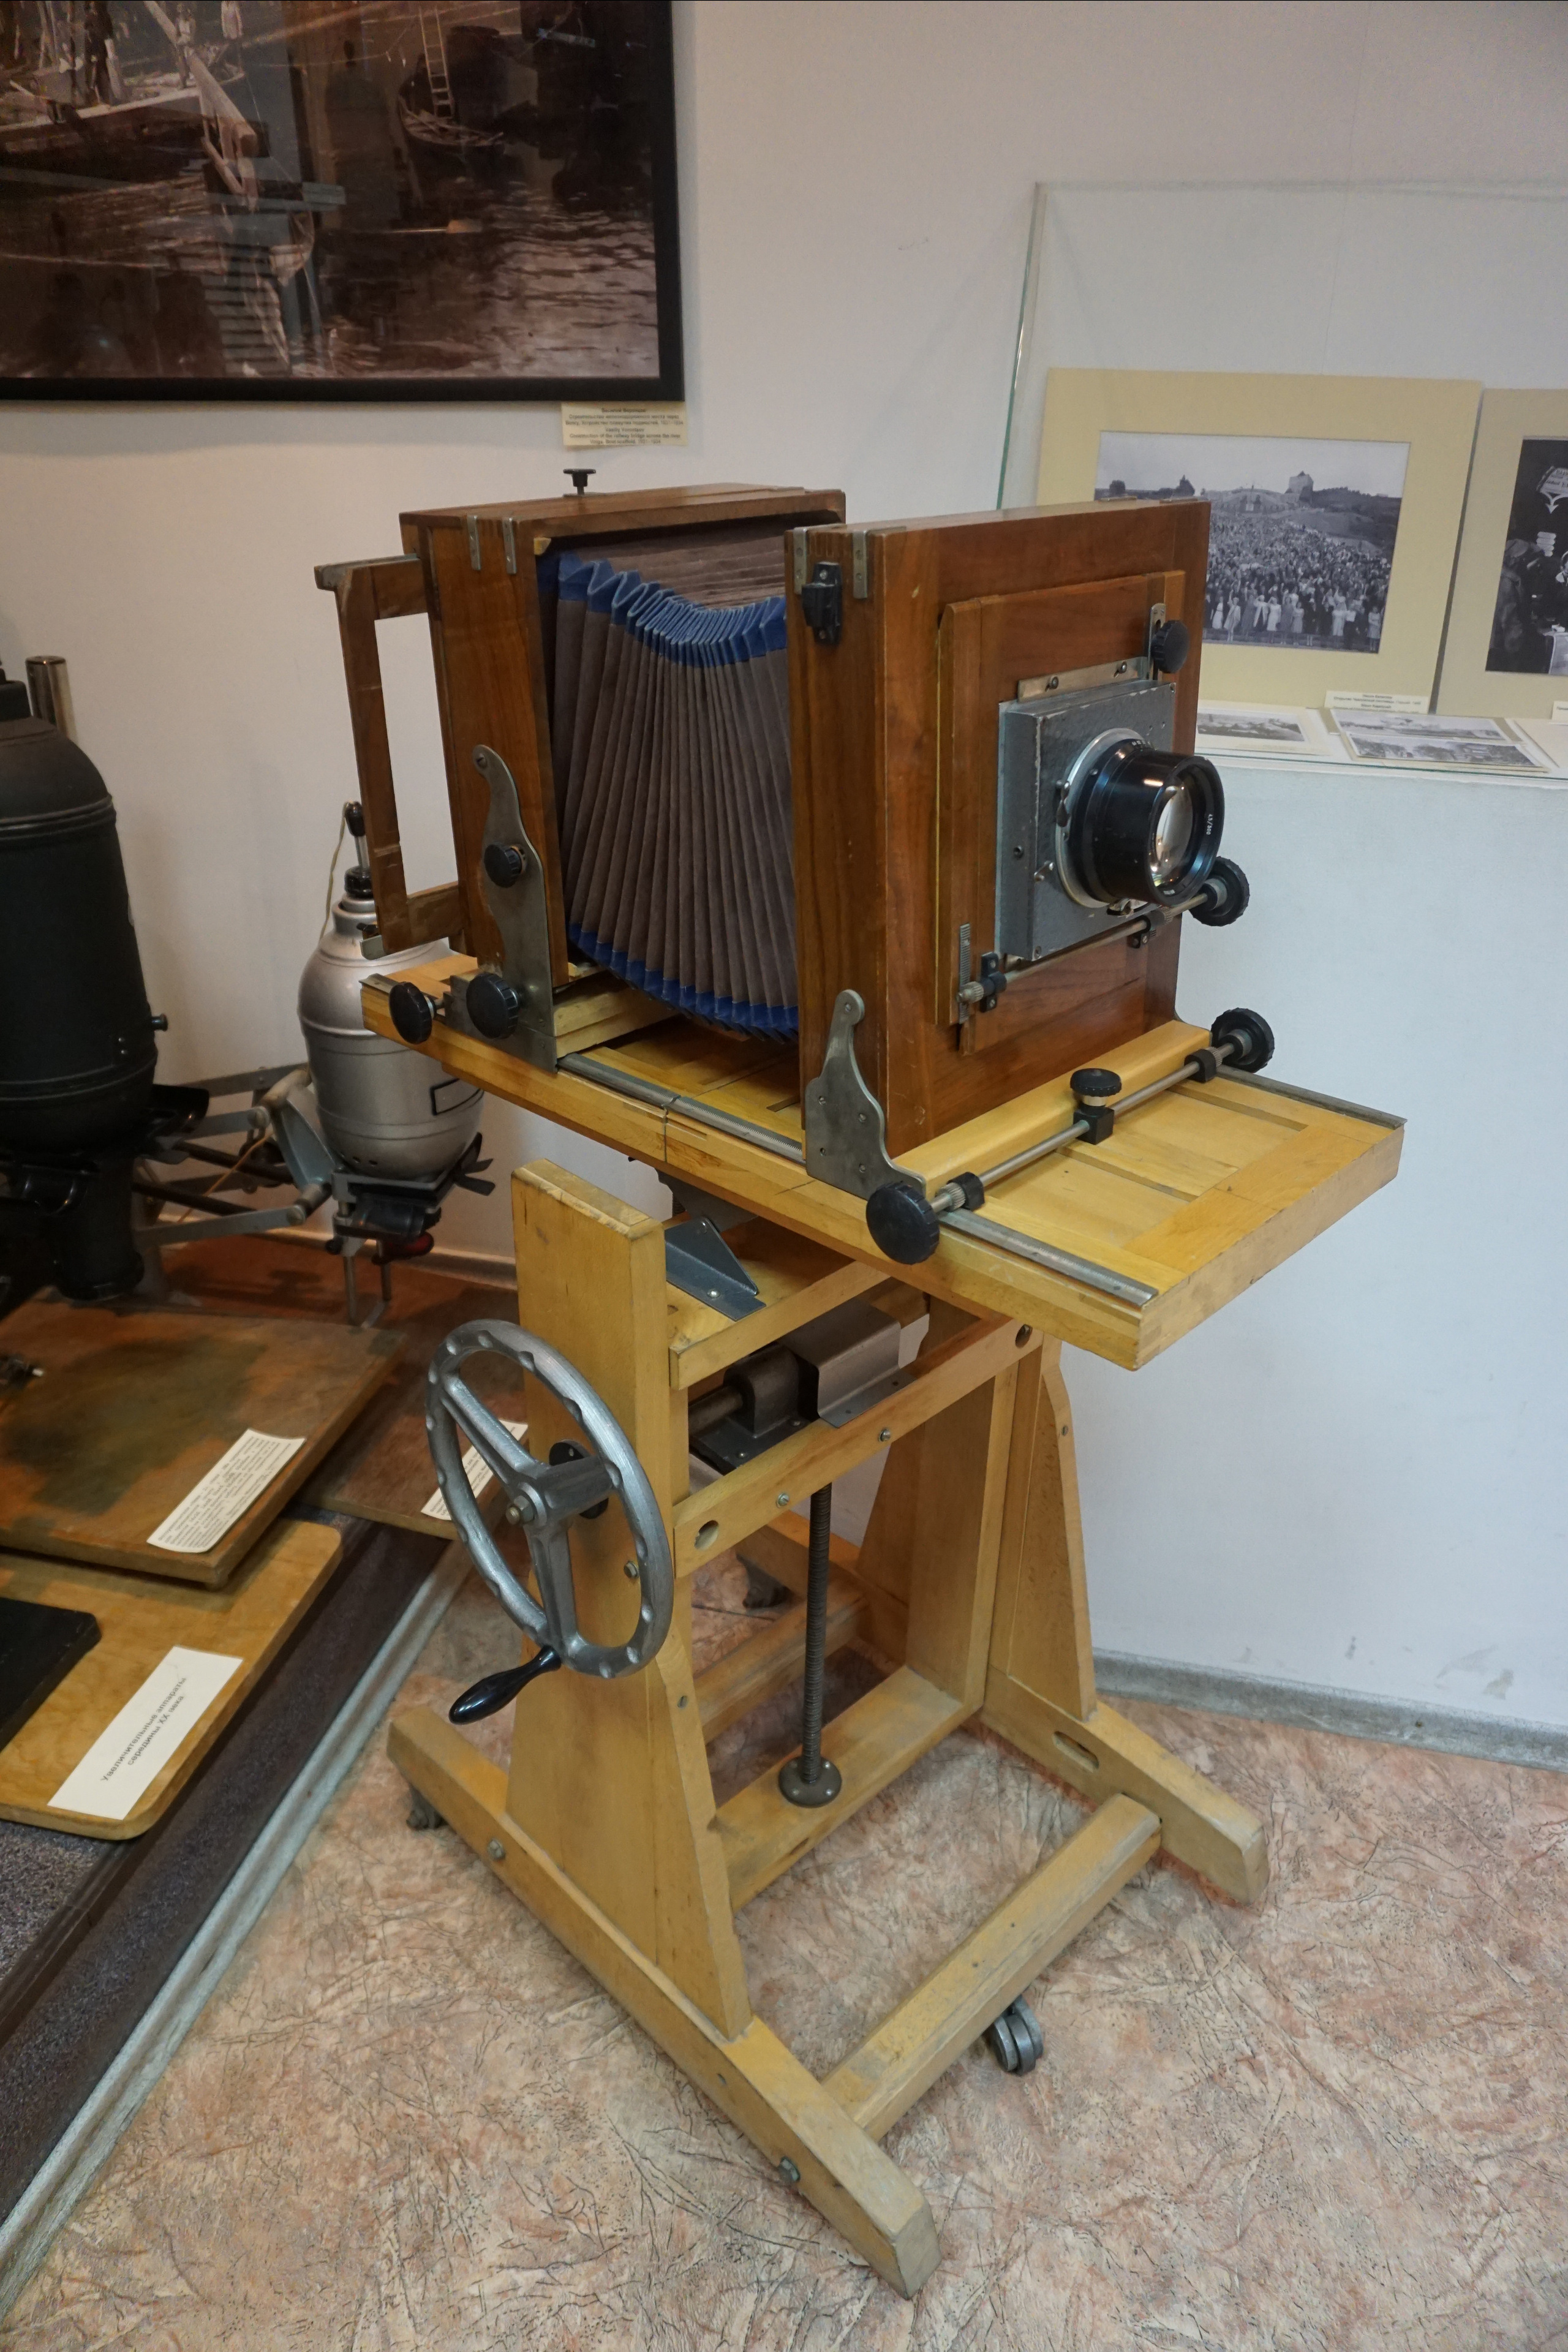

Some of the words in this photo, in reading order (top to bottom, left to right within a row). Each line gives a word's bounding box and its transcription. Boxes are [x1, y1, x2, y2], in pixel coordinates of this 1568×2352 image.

[100, 1714, 158, 1782] Увеличительные
[156, 1677, 187, 1713] аппараты
[127, 1726, 161, 1766] середины
[168, 1695, 184, 1713] века
